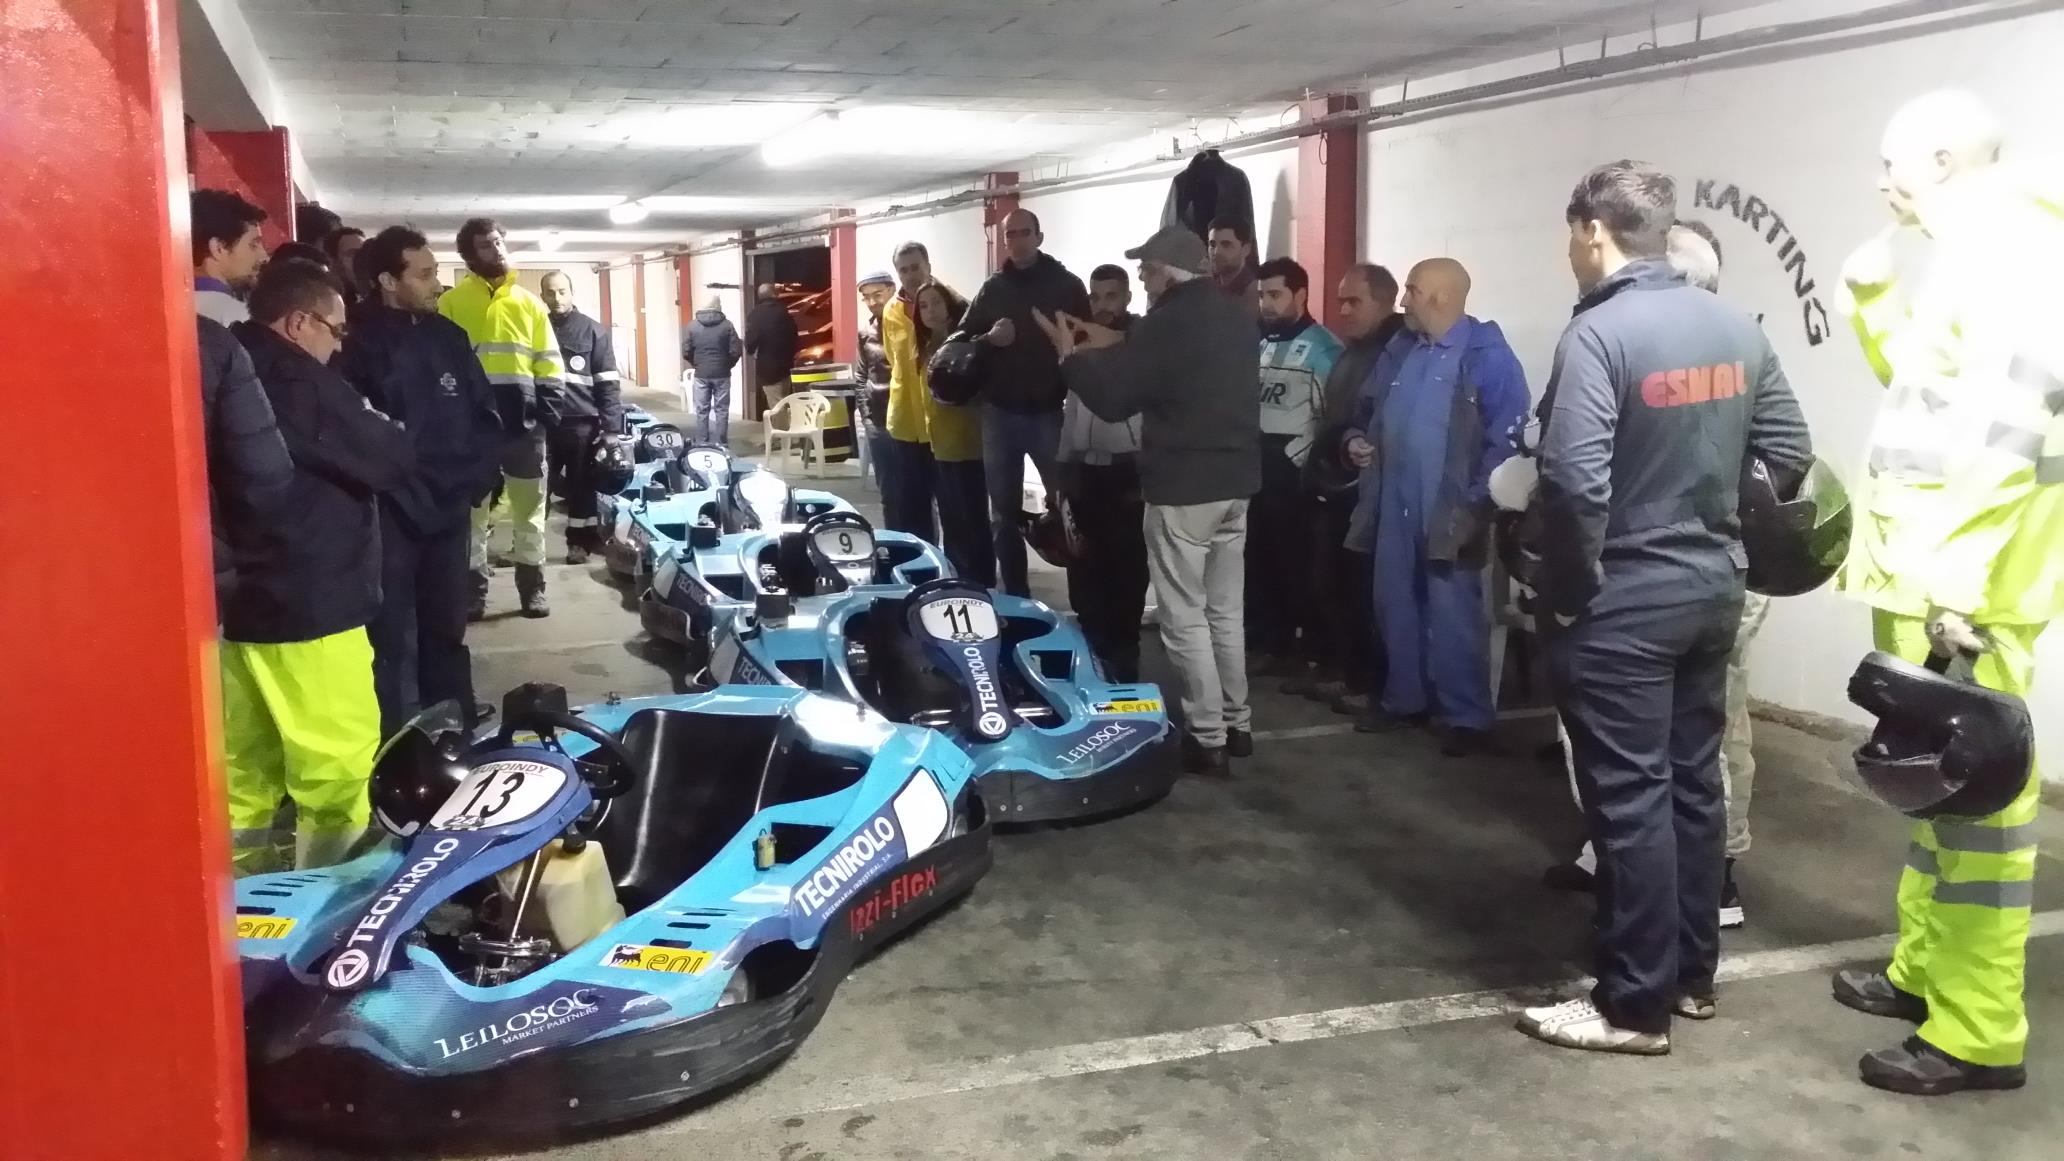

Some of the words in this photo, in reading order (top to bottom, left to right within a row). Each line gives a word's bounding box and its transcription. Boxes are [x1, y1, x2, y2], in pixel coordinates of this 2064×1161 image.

[1694, 180, 1830, 347] KARTING
[655, 433, 674, 447] 30
[703, 454, 713, 469] 5
[838, 531, 853, 554] 9
[942, 604, 973, 633] 11
[1056, 721, 1131, 764] LEILOSOC
[470, 761, 549, 776] EUROINDY
[460, 769, 526, 819] 13
[794, 816, 895, 917] TECNIROLO
[346, 838, 459, 948] TECNIROLO
[238, 918, 291, 939] eni
[646, 951, 707, 975] eni
[433, 987, 600, 1059] LEILOSOC
[502, 1026, 545, 1046] MARKET
[547, 1004, 600, 1031] PARTNERS
